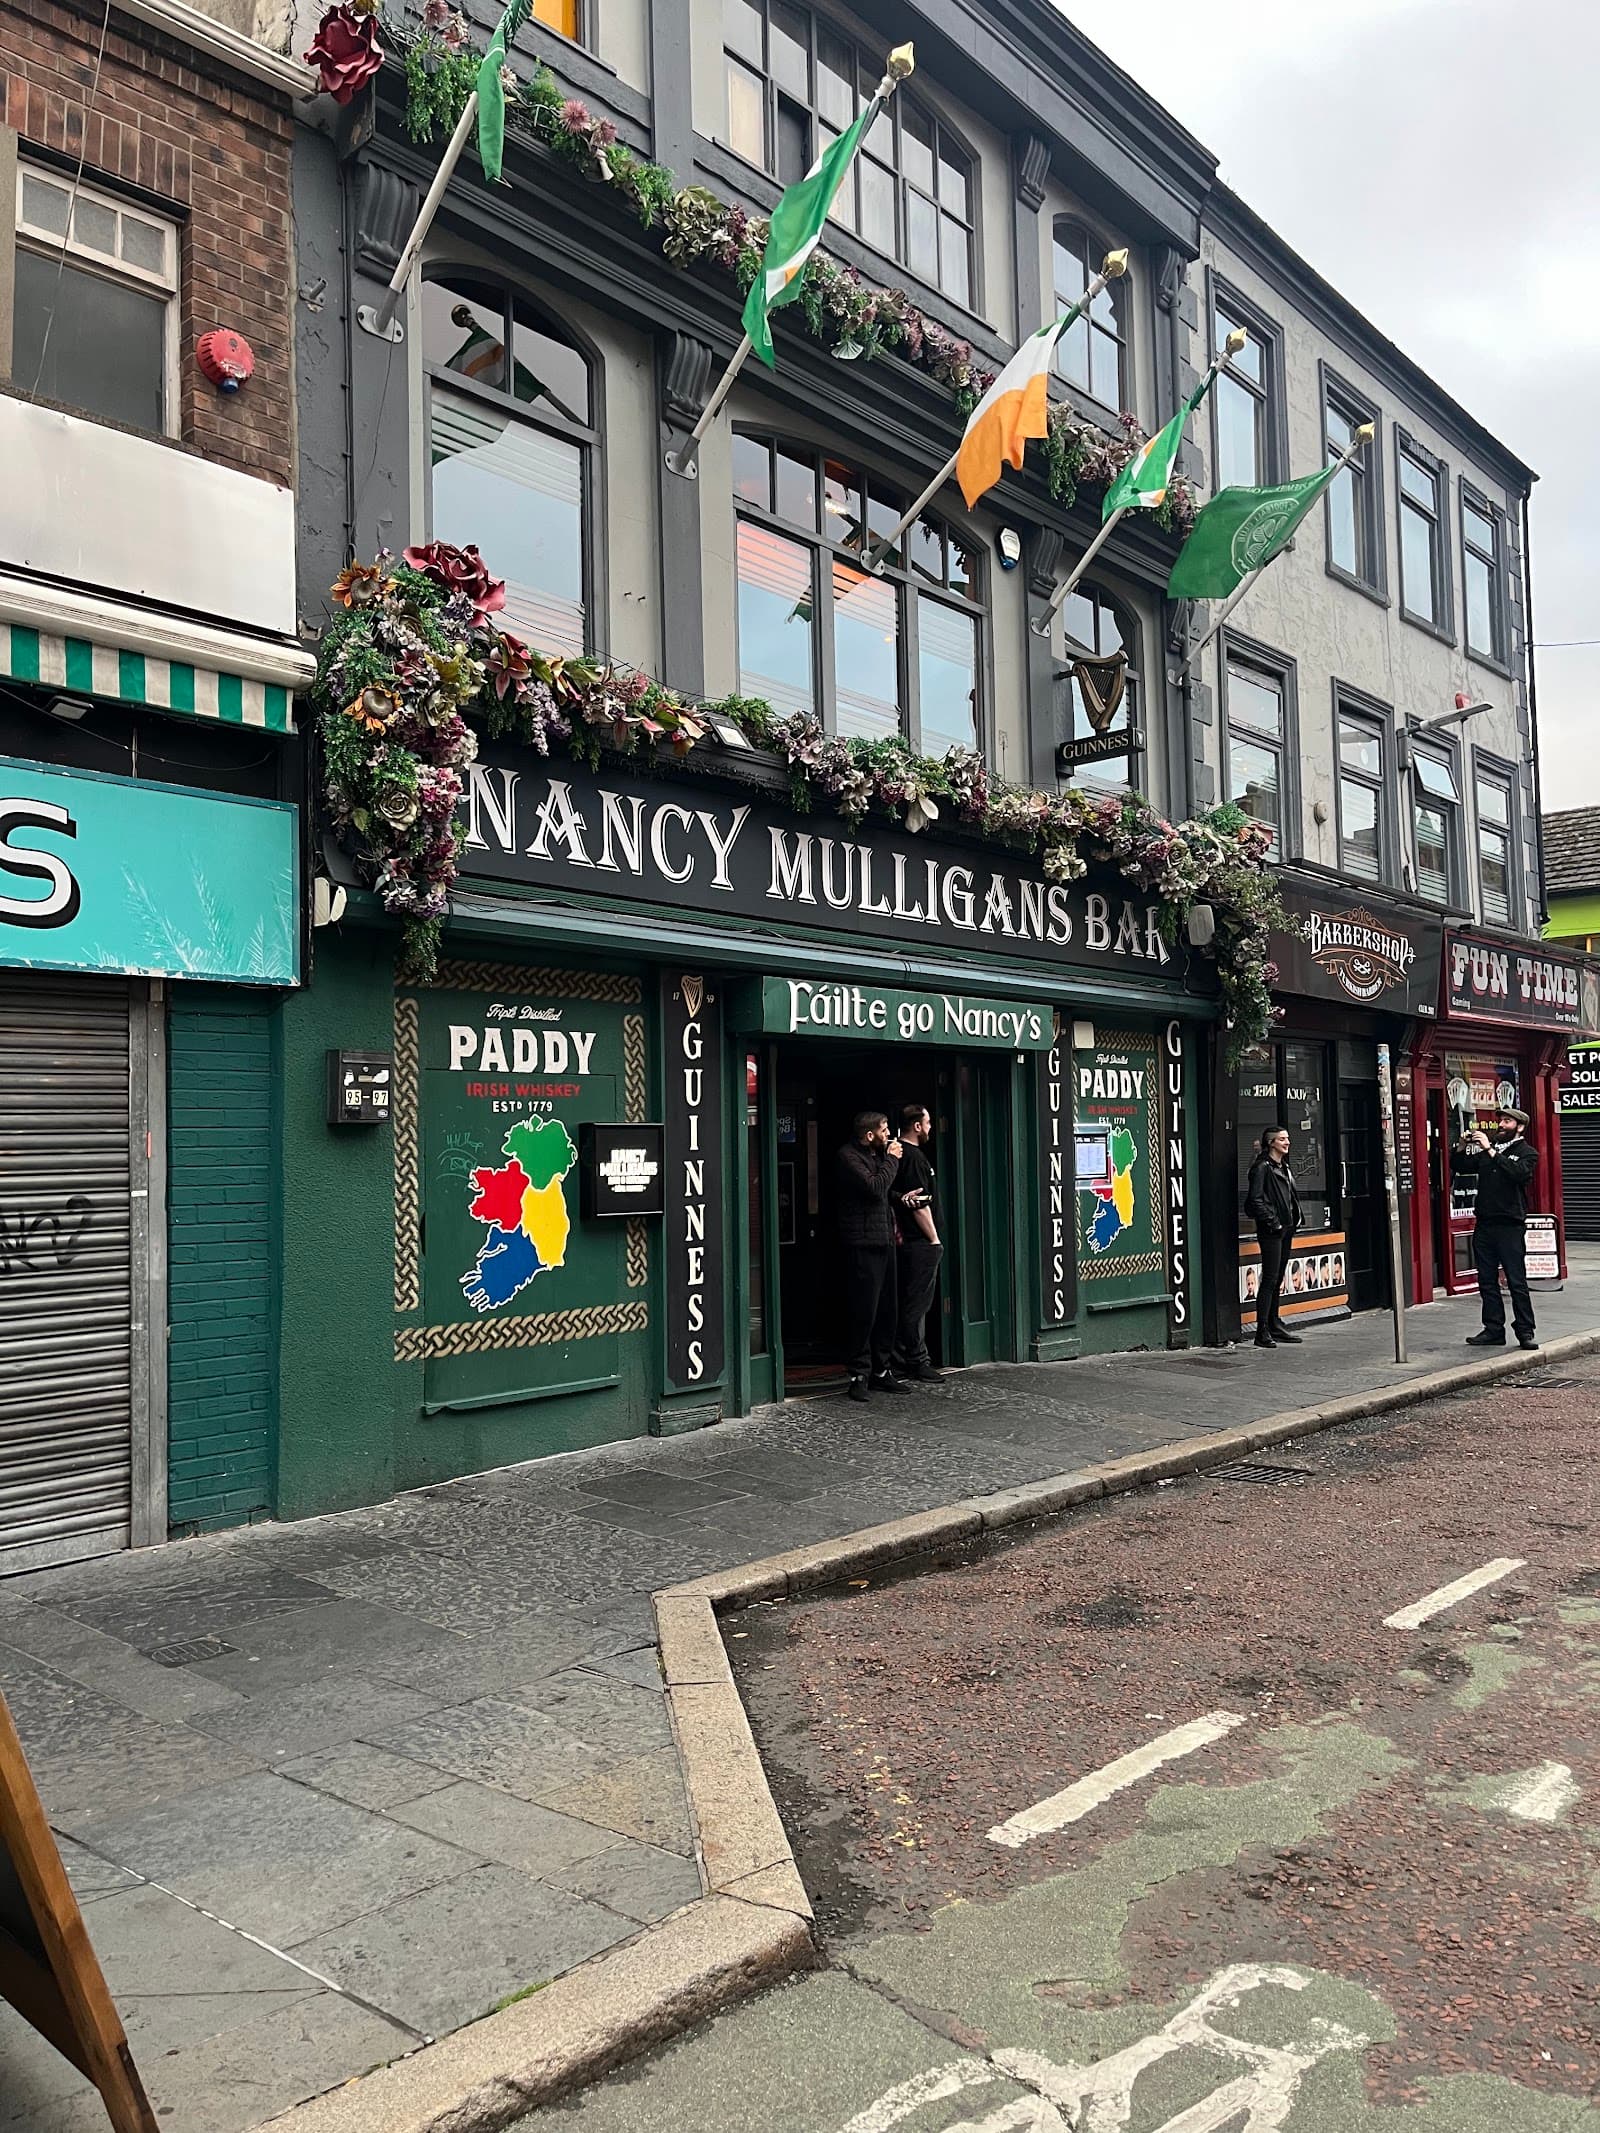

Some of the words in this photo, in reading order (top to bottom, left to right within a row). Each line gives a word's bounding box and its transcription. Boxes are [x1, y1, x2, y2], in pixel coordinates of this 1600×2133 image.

[1062, 733, 1129, 759] GUINNESS
[464, 762, 752, 892] NANCY
[765, 826, 1073, 946] MULLIGANS
[1300, 912, 1416, 975] BARBERSHOP
[1451, 942, 1509, 999] FUN
[1516, 957, 1579, 1010] TIME
[518, 1005, 563, 1021] Distilled
[897, 1002, 934, 1039] go
[941, 996, 1041, 1047] Nancy's
[448, 1025, 597, 1075] PADDY
[1589, 1051, 1600, 1064] P
[347, 1091, 360, 1104] 95
[374, 1092, 387, 1104] 97
[466, 1082, 510, 1098] IRISH
[515, 1083, 581, 1097] WHISKEY
[1080, 1067, 1144, 1100] PADDY
[1571, 1070, 1600, 1084] SOL
[528, 1101, 553, 1113] 1779
[1048, 1047, 1065, 1321] GUINNESS
[1166, 1020, 1186, 1325] GUINNESS
[682, 1022, 705, 1381] GUINNESS
